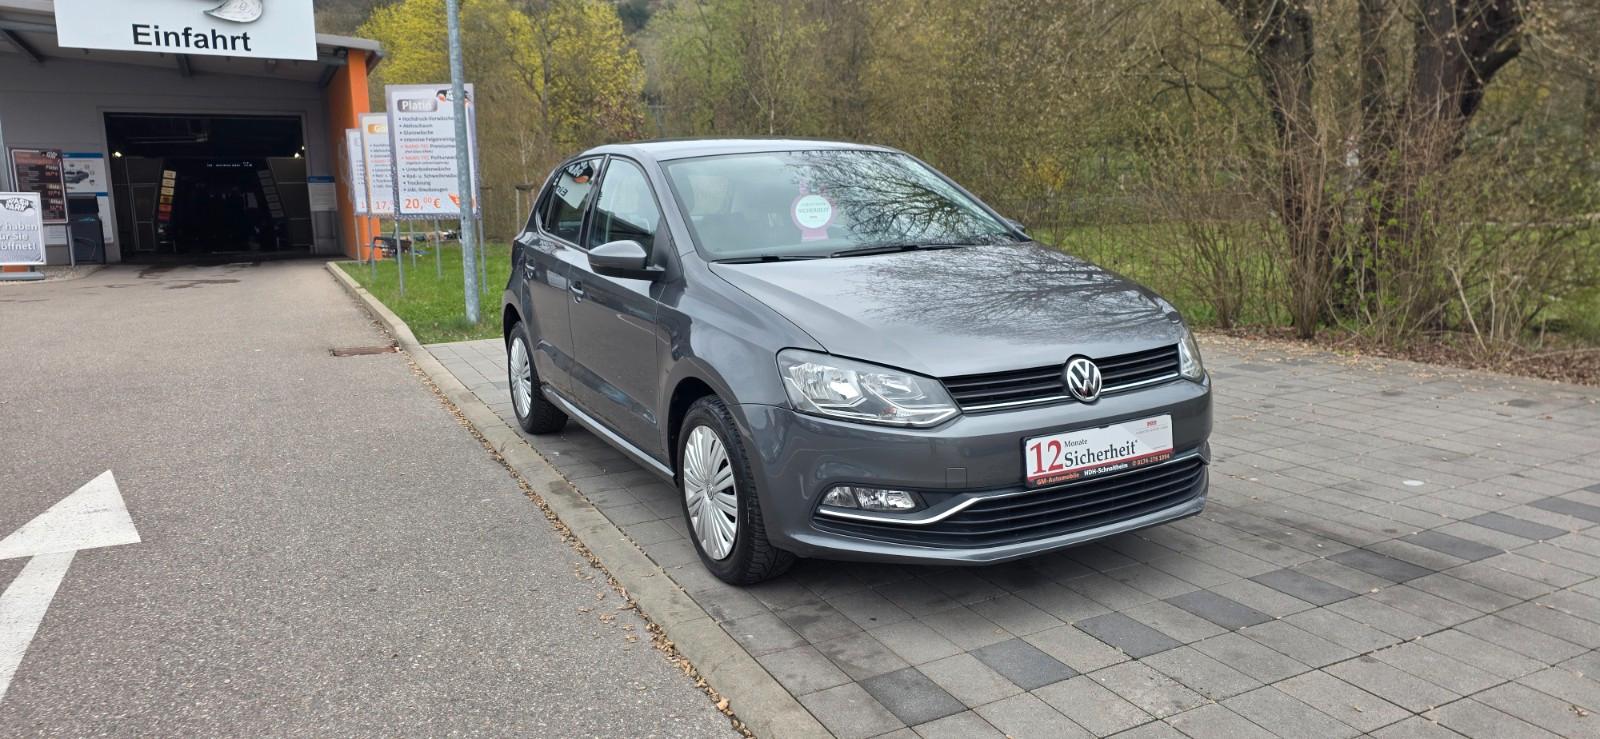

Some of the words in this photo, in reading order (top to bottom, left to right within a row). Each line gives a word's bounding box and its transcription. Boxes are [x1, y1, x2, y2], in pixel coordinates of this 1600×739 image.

[132, 23, 252, 51] Einfahrt
[6, 222, 39, 231] haben
[1064, 438, 1088, 448] Monate
[1030, 439, 1064, 475] 12
